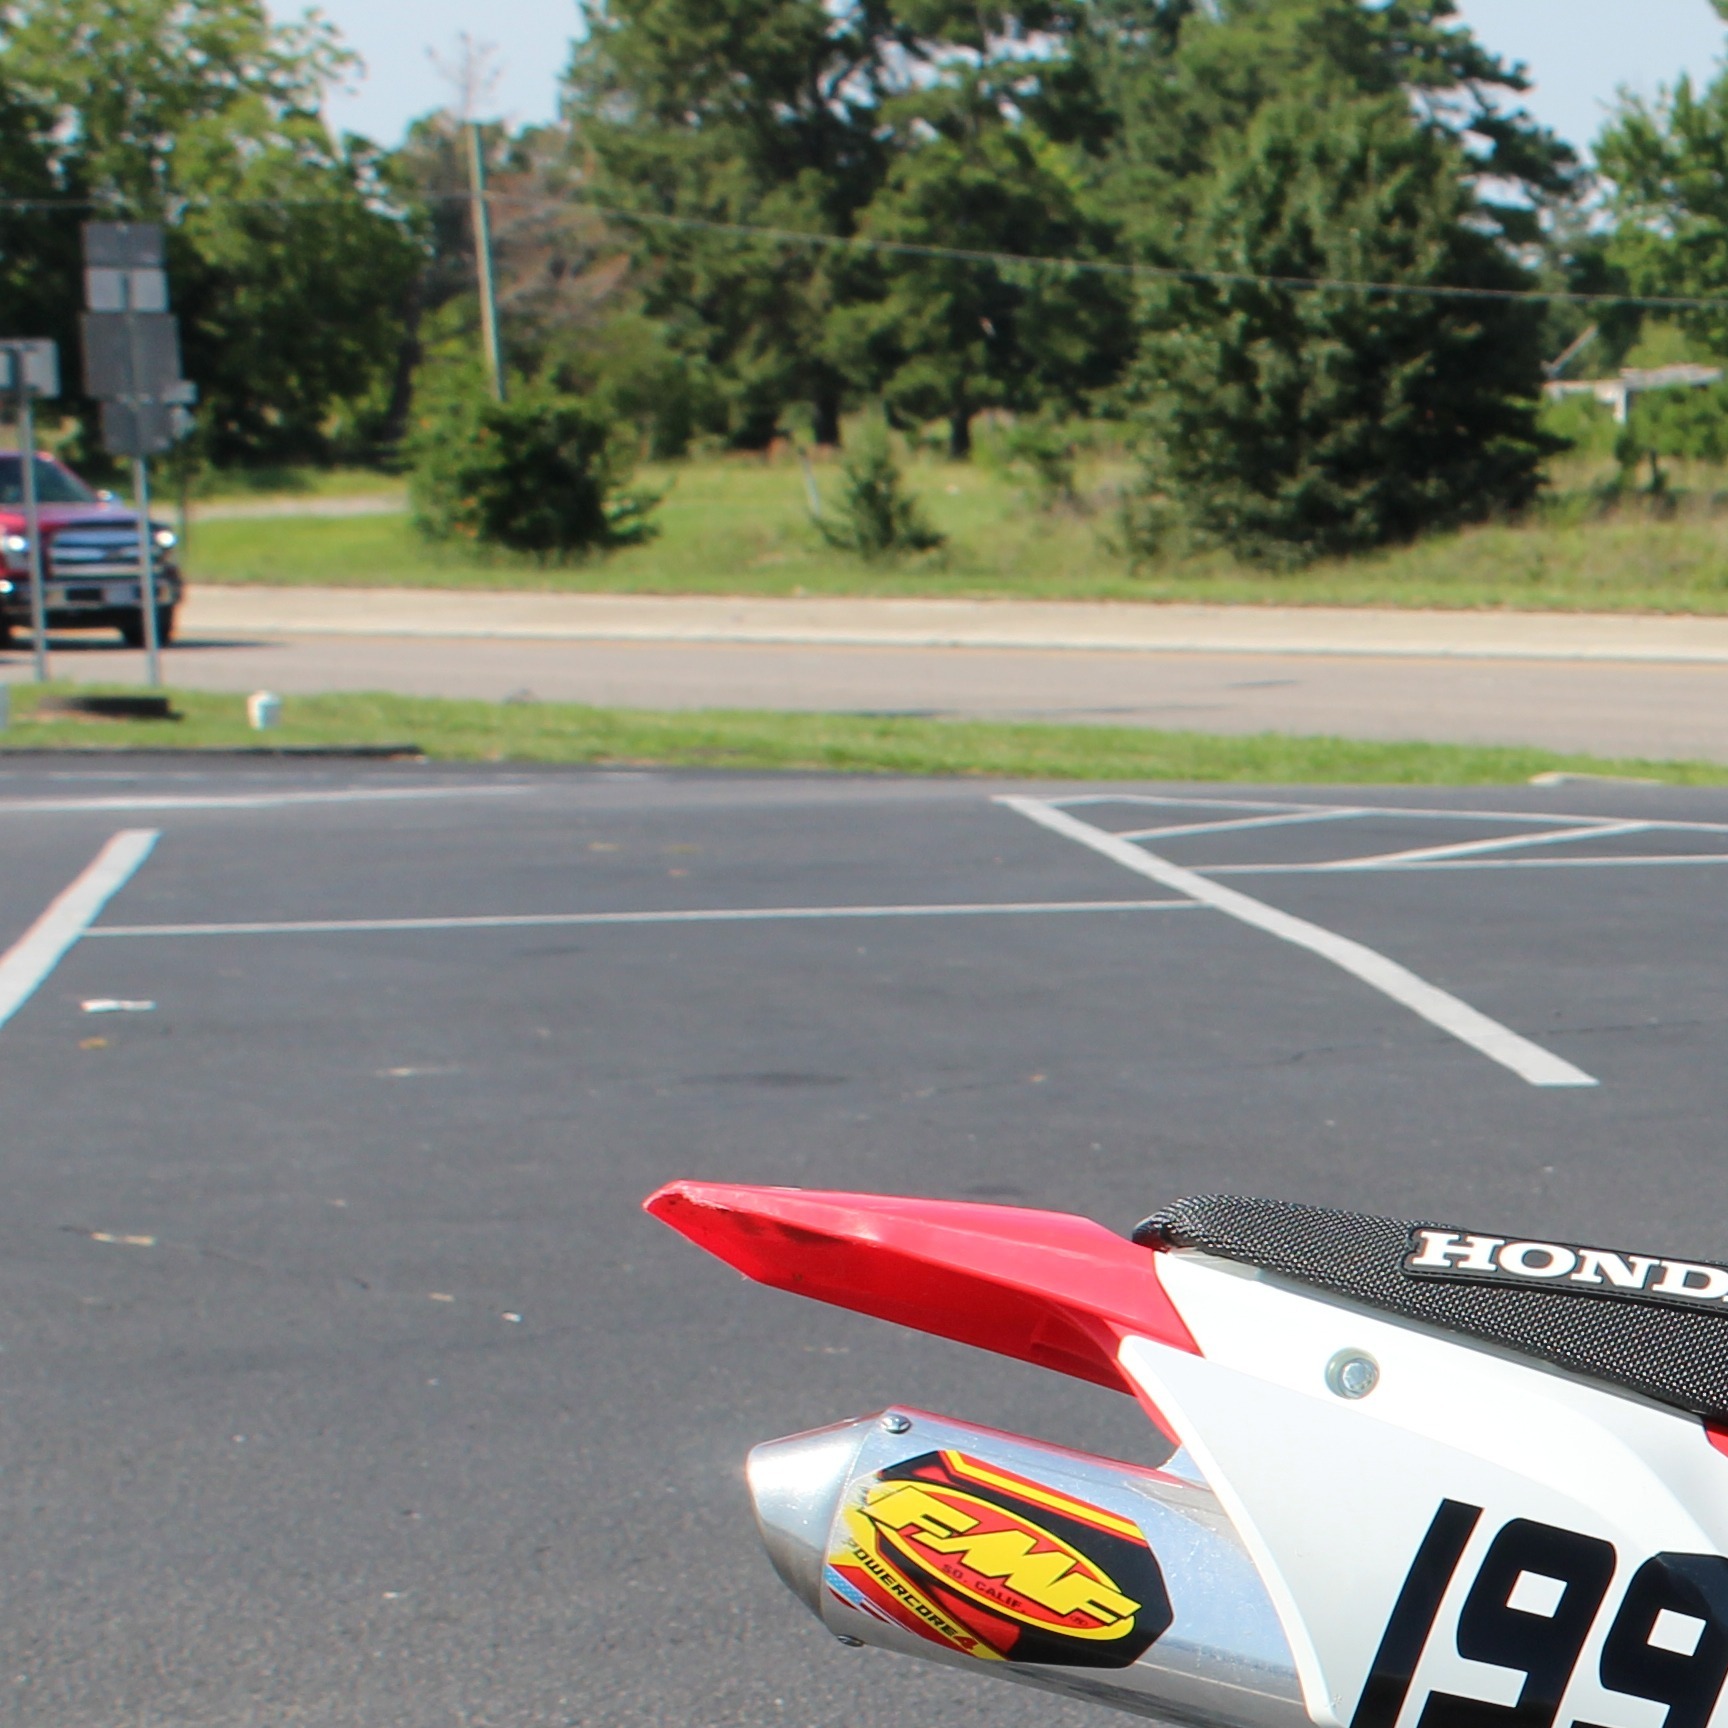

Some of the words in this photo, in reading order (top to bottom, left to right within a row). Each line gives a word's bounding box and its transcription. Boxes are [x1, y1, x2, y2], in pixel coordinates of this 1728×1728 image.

[858, 1485, 1143, 1627] FMF
[941, 1563, 968, 1584] SO.
[974, 1580, 1027, 1614] CALIF.
